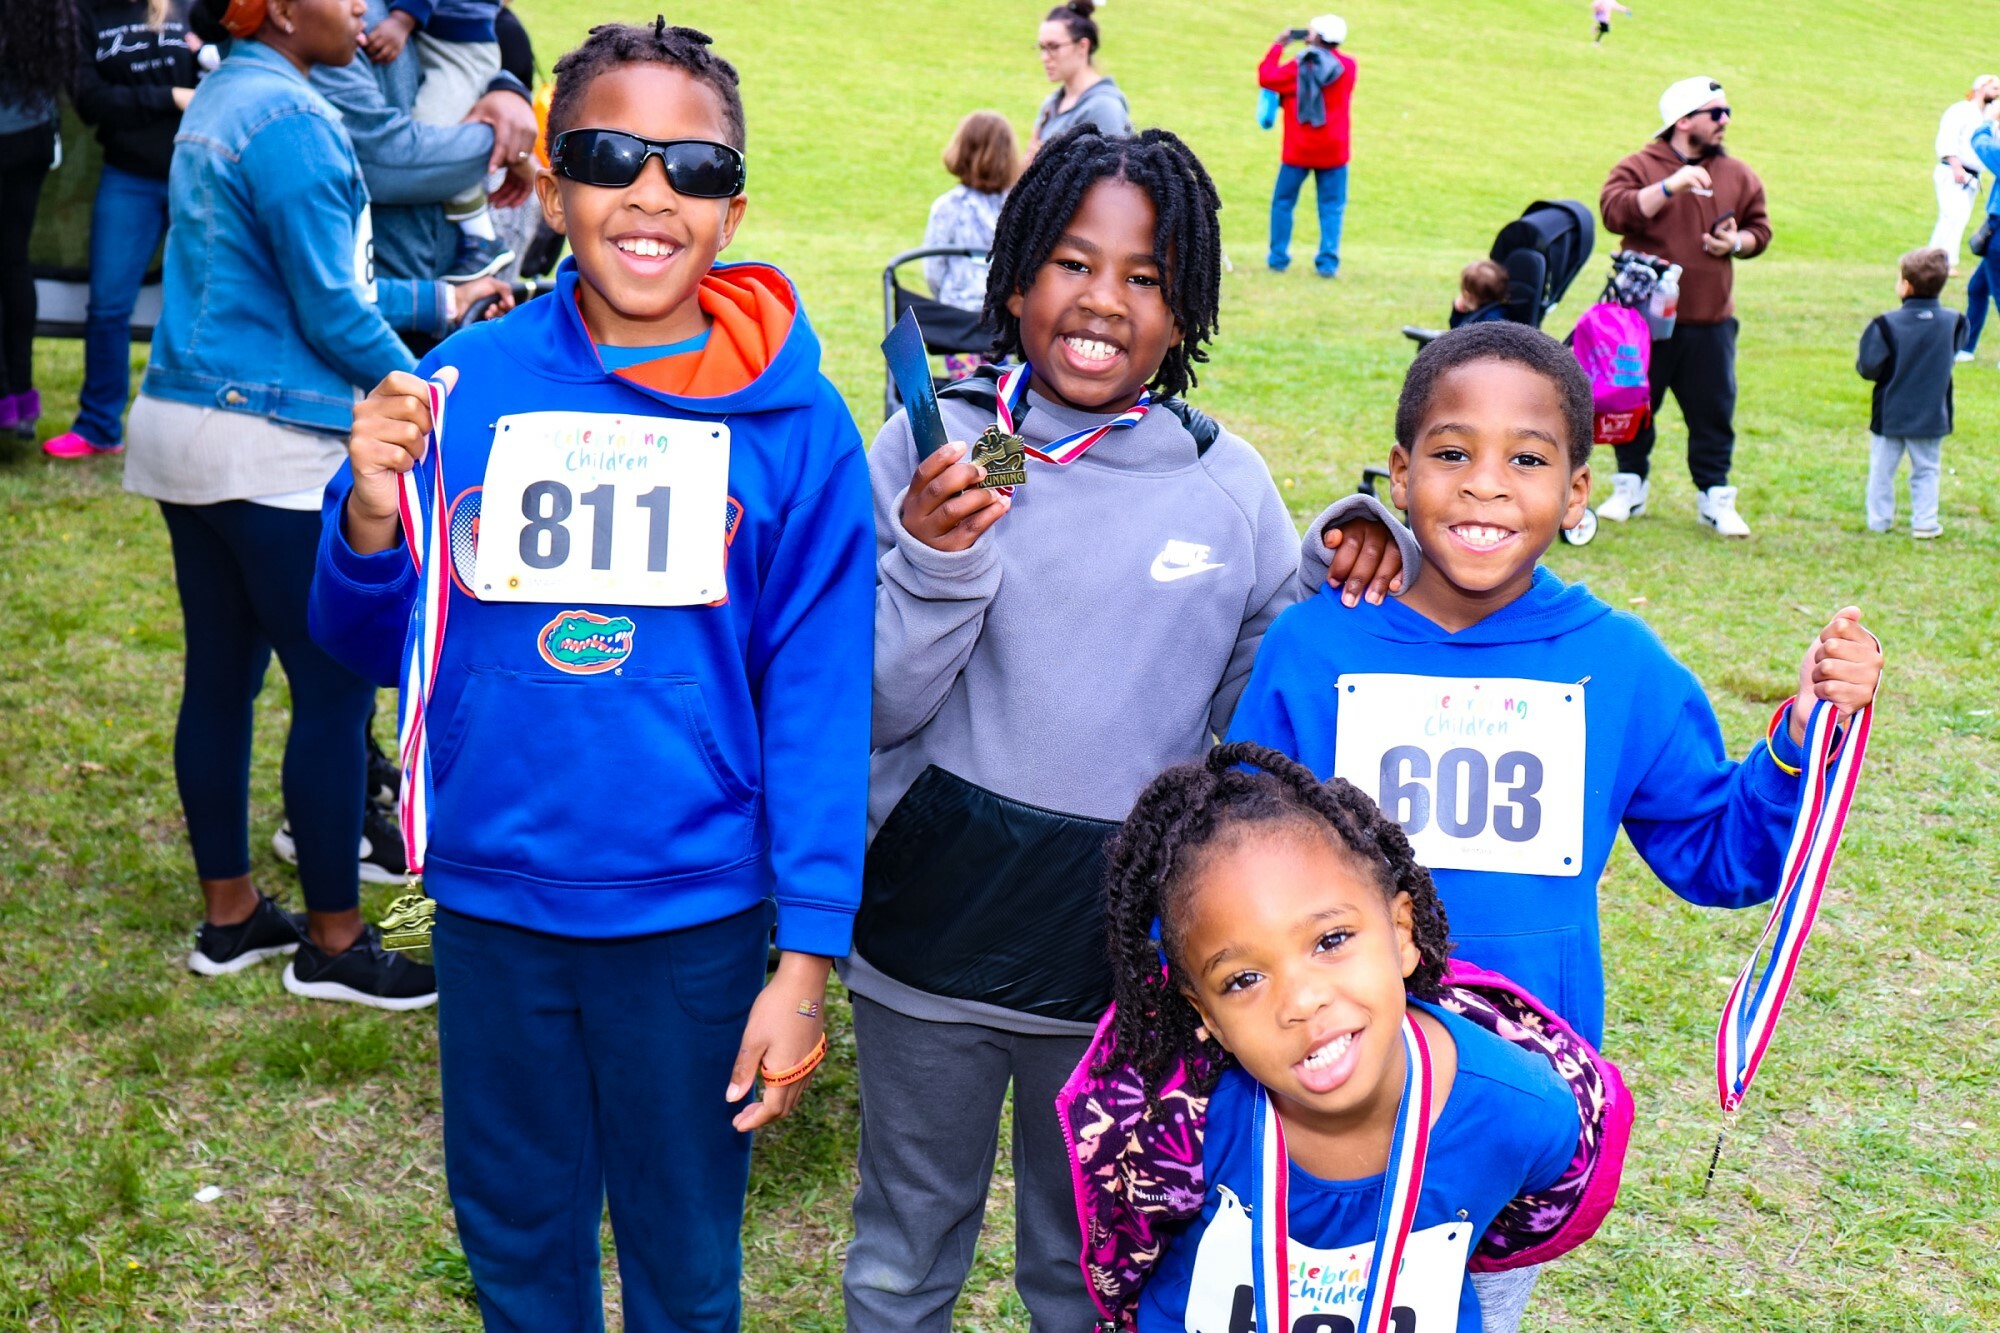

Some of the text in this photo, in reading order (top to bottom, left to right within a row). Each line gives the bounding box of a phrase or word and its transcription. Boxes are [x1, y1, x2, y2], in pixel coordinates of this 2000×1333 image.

[553, 427, 669, 454] Celerang
[565, 447, 649, 472] Children
[518, 480, 671, 573] 811
[1424, 712, 1508, 737] Children
[1379, 744, 1544, 842] 603
[1289, 1279, 1367, 1305] Childre
